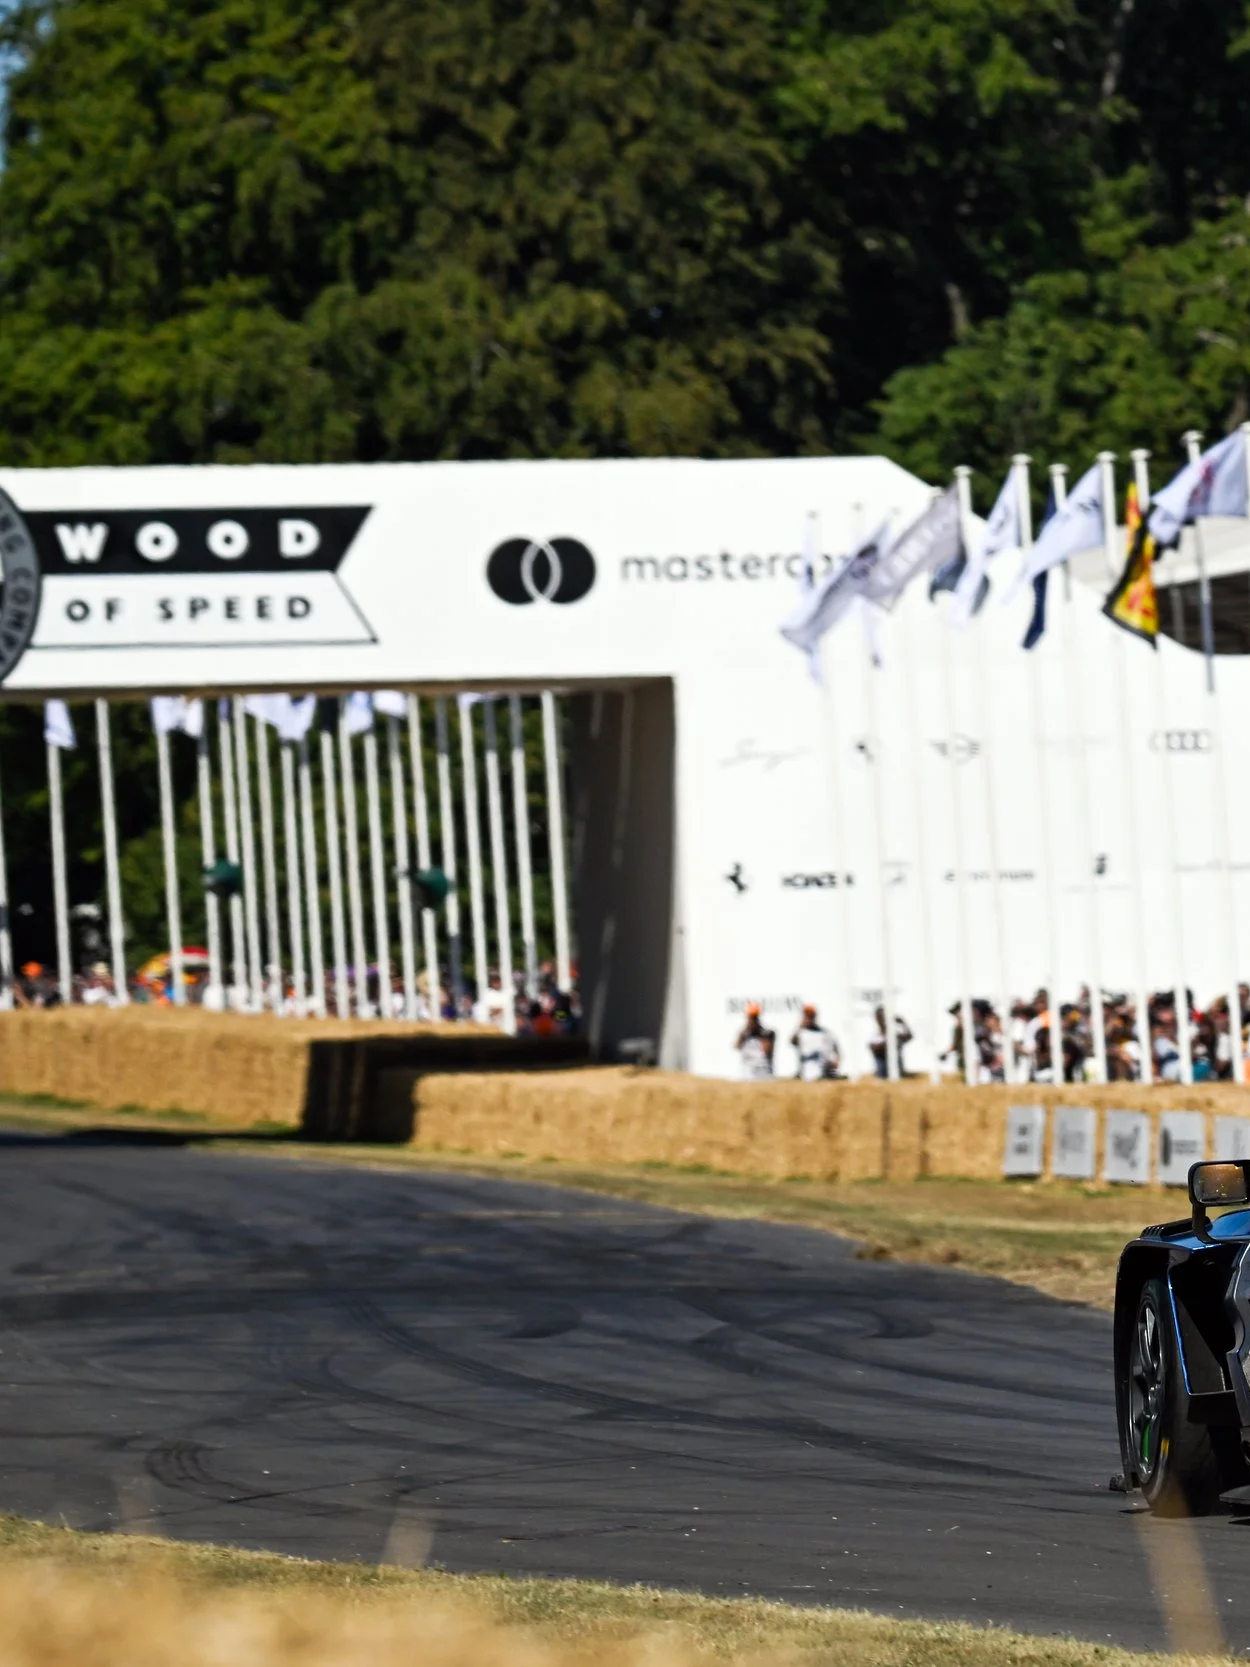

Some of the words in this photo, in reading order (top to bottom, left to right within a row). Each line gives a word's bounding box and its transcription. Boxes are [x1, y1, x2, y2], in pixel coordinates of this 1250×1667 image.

[54, 518, 321, 564] WOOD
[619, 547, 850, 582] masterc
[65, 598, 119, 623] OF
[158, 594, 312, 622] SPEED
